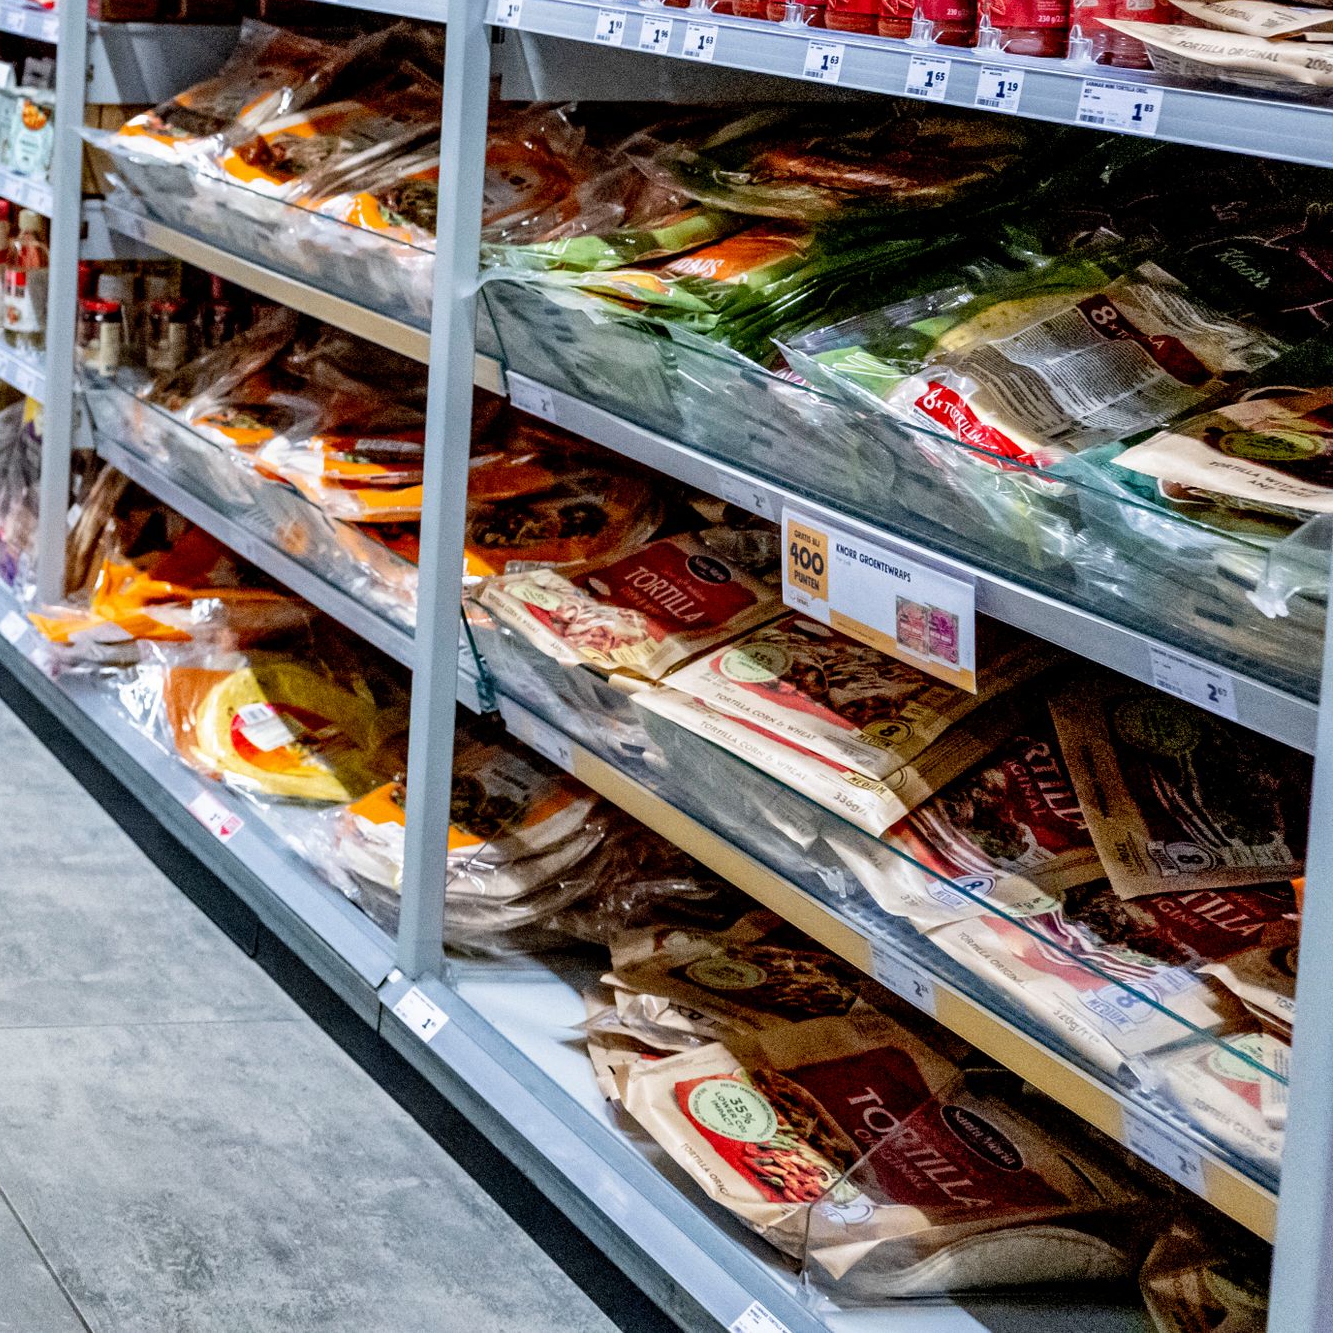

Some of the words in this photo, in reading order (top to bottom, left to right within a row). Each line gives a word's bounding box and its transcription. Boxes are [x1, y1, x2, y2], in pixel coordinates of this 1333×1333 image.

[697, 35, 714, 50] 163
[1176, 39, 1225, 55] TORTILLA
[1227, 47, 1279, 63] ORIGINAL
[821, 54, 839, 71] 163
[924, 70, 946, 88] 165
[996, 79, 1019, 99] 119
[1131, 102, 1154, 122] 183
[794, 529, 812, 545] GRATIS
[789, 542, 824, 577] 400
[836, 543, 858, 562] KNORR
[859, 552, 912, 584] GROENTEWRAPS
[623, 565, 706, 624] TORTILLA
[793, 569, 821, 592] PUNTEN
[714, 691, 750, 714] TORTILLA
[751, 708, 777, 725] CORN
[787, 723, 816, 742] WHEAT
[879, 723, 900, 739] 8
[700, 719, 737, 745] TORTILLA
[739, 737, 765, 759] CORN
[776, 758, 809, 782] WHEAT
[858, 731, 894, 749] MEDIUM
[848, 774, 888, 797] MEDIUM
[957, 931, 990, 961] TORTILLA
[1087, 994, 1128, 1027] MEDIUM
[710, 1098, 734, 1127] IMPACT
[714, 1091, 738, 1122] LOWER
[729, 1096, 757, 1126] 35%
[846, 1086, 993, 1208] TORTILLA
[953, 1109, 984, 1140] Santa
[984, 1135, 1017, 1167] Maria
[681, 1141, 711, 1179] TORTILLA
